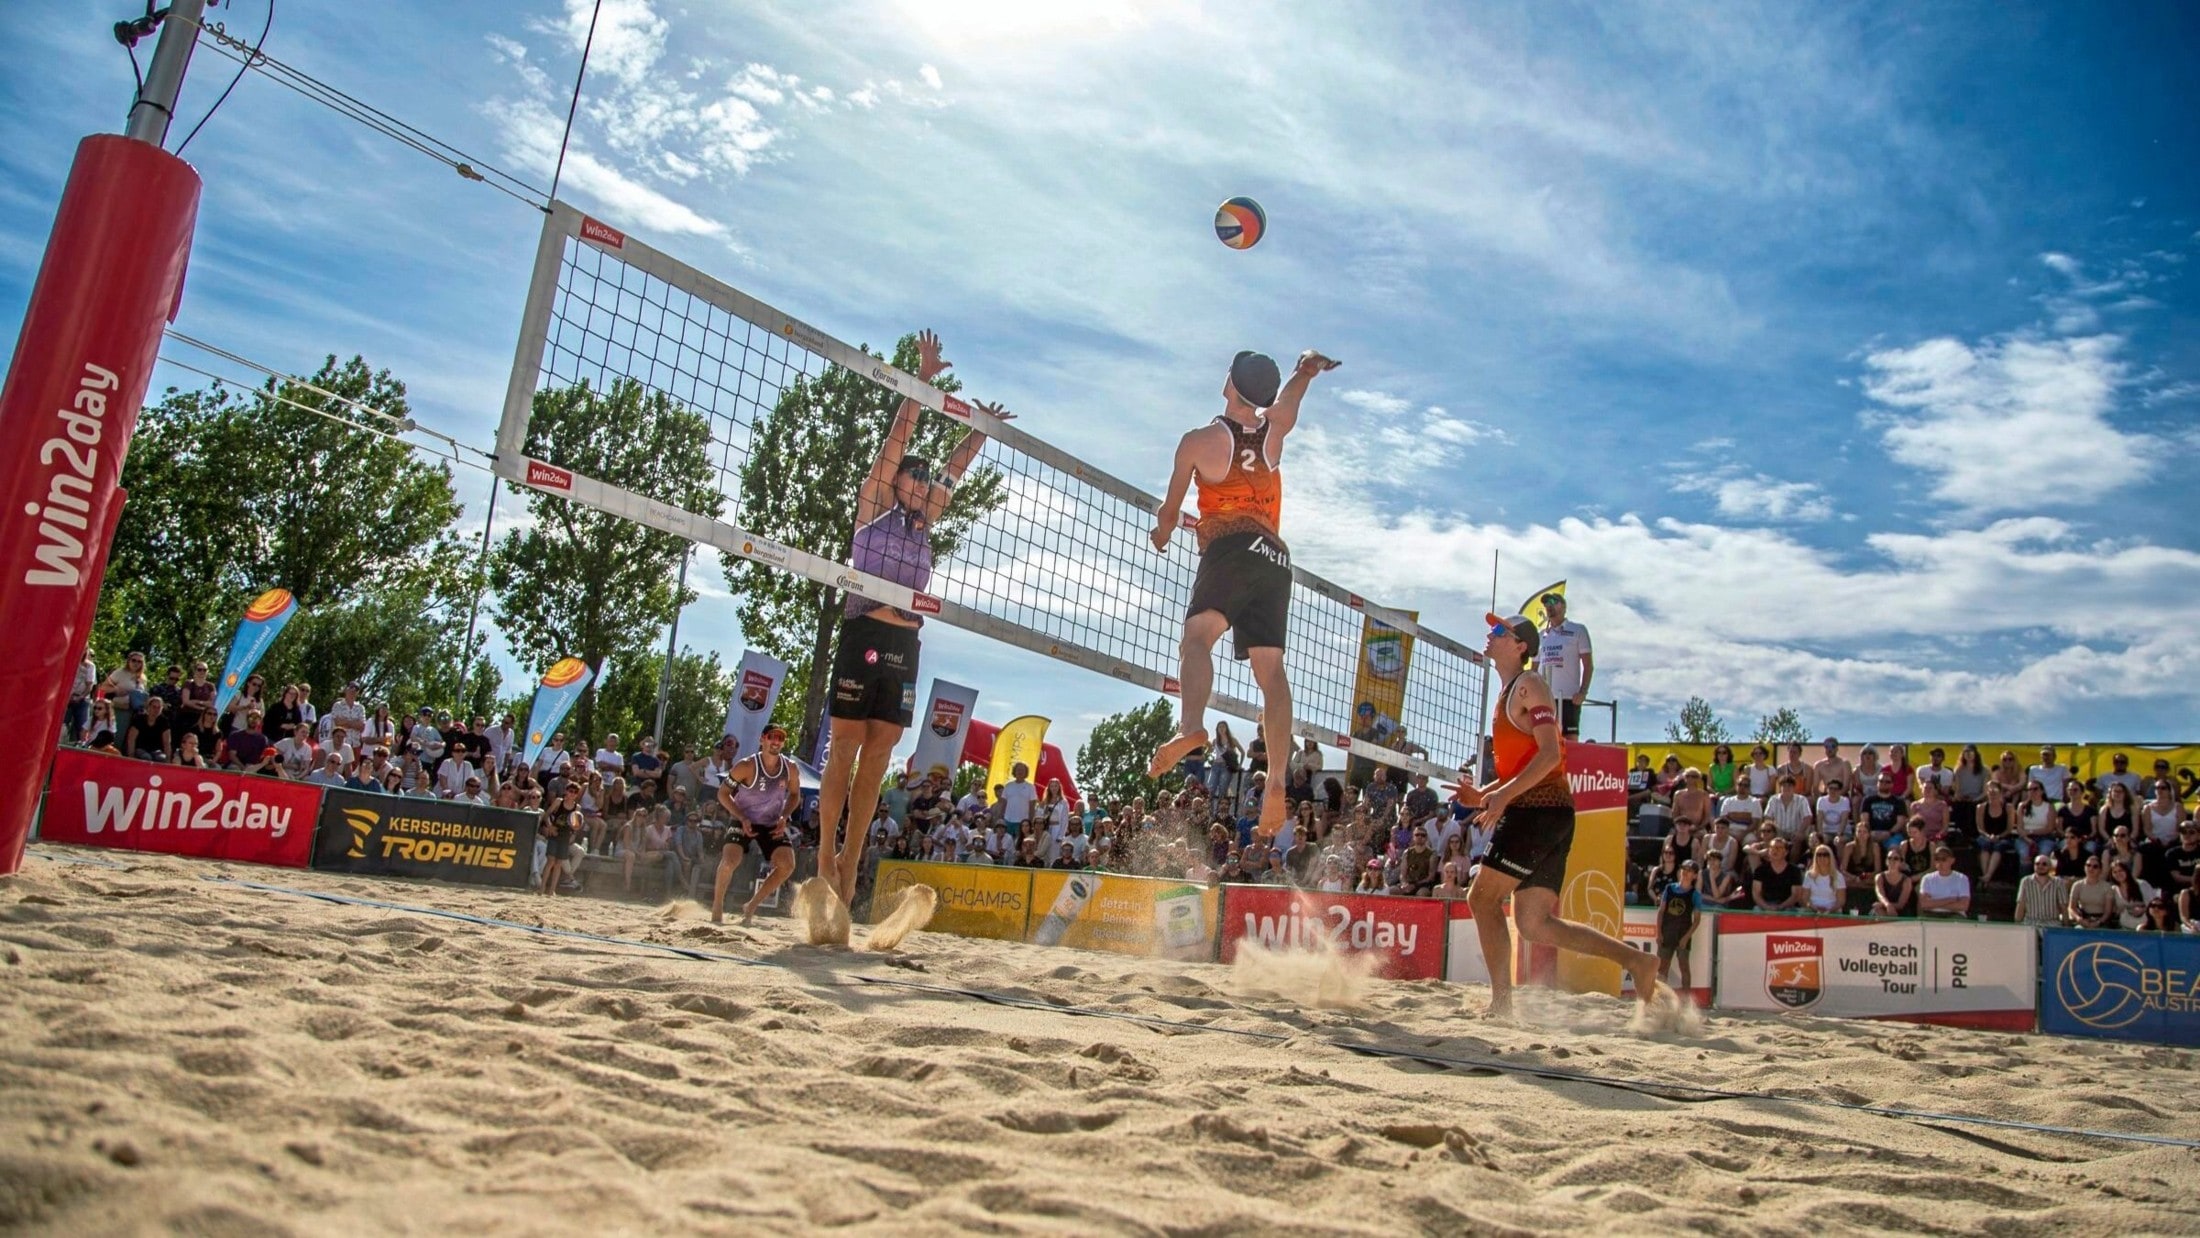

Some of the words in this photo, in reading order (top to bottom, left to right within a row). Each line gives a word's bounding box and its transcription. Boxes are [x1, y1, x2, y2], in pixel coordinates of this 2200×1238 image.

[1240, 448, 1256, 472] 2
[25, 362, 119, 586] win2day
[531, 468, 568, 487] win2day
[836, 574, 865, 592] Corona
[759, 782, 766, 791] 2
[1566, 768, 1625, 794] win2day
[83, 775, 292, 838] win2day
[388, 816, 515, 844] KERSCHBAUMER
[381, 835, 517, 870] TROPHIES
[935, 881, 1022, 911] ACHCAMPS
[1245, 902, 1418, 956] win2day
[1773, 941, 1817, 955] win2day
[1868, 942, 1918, 958] Beach
[1839, 958, 1918, 977] Volleyball
[1951, 953, 1968, 989] PRO
[1881, 979, 1918, 995] Tour
